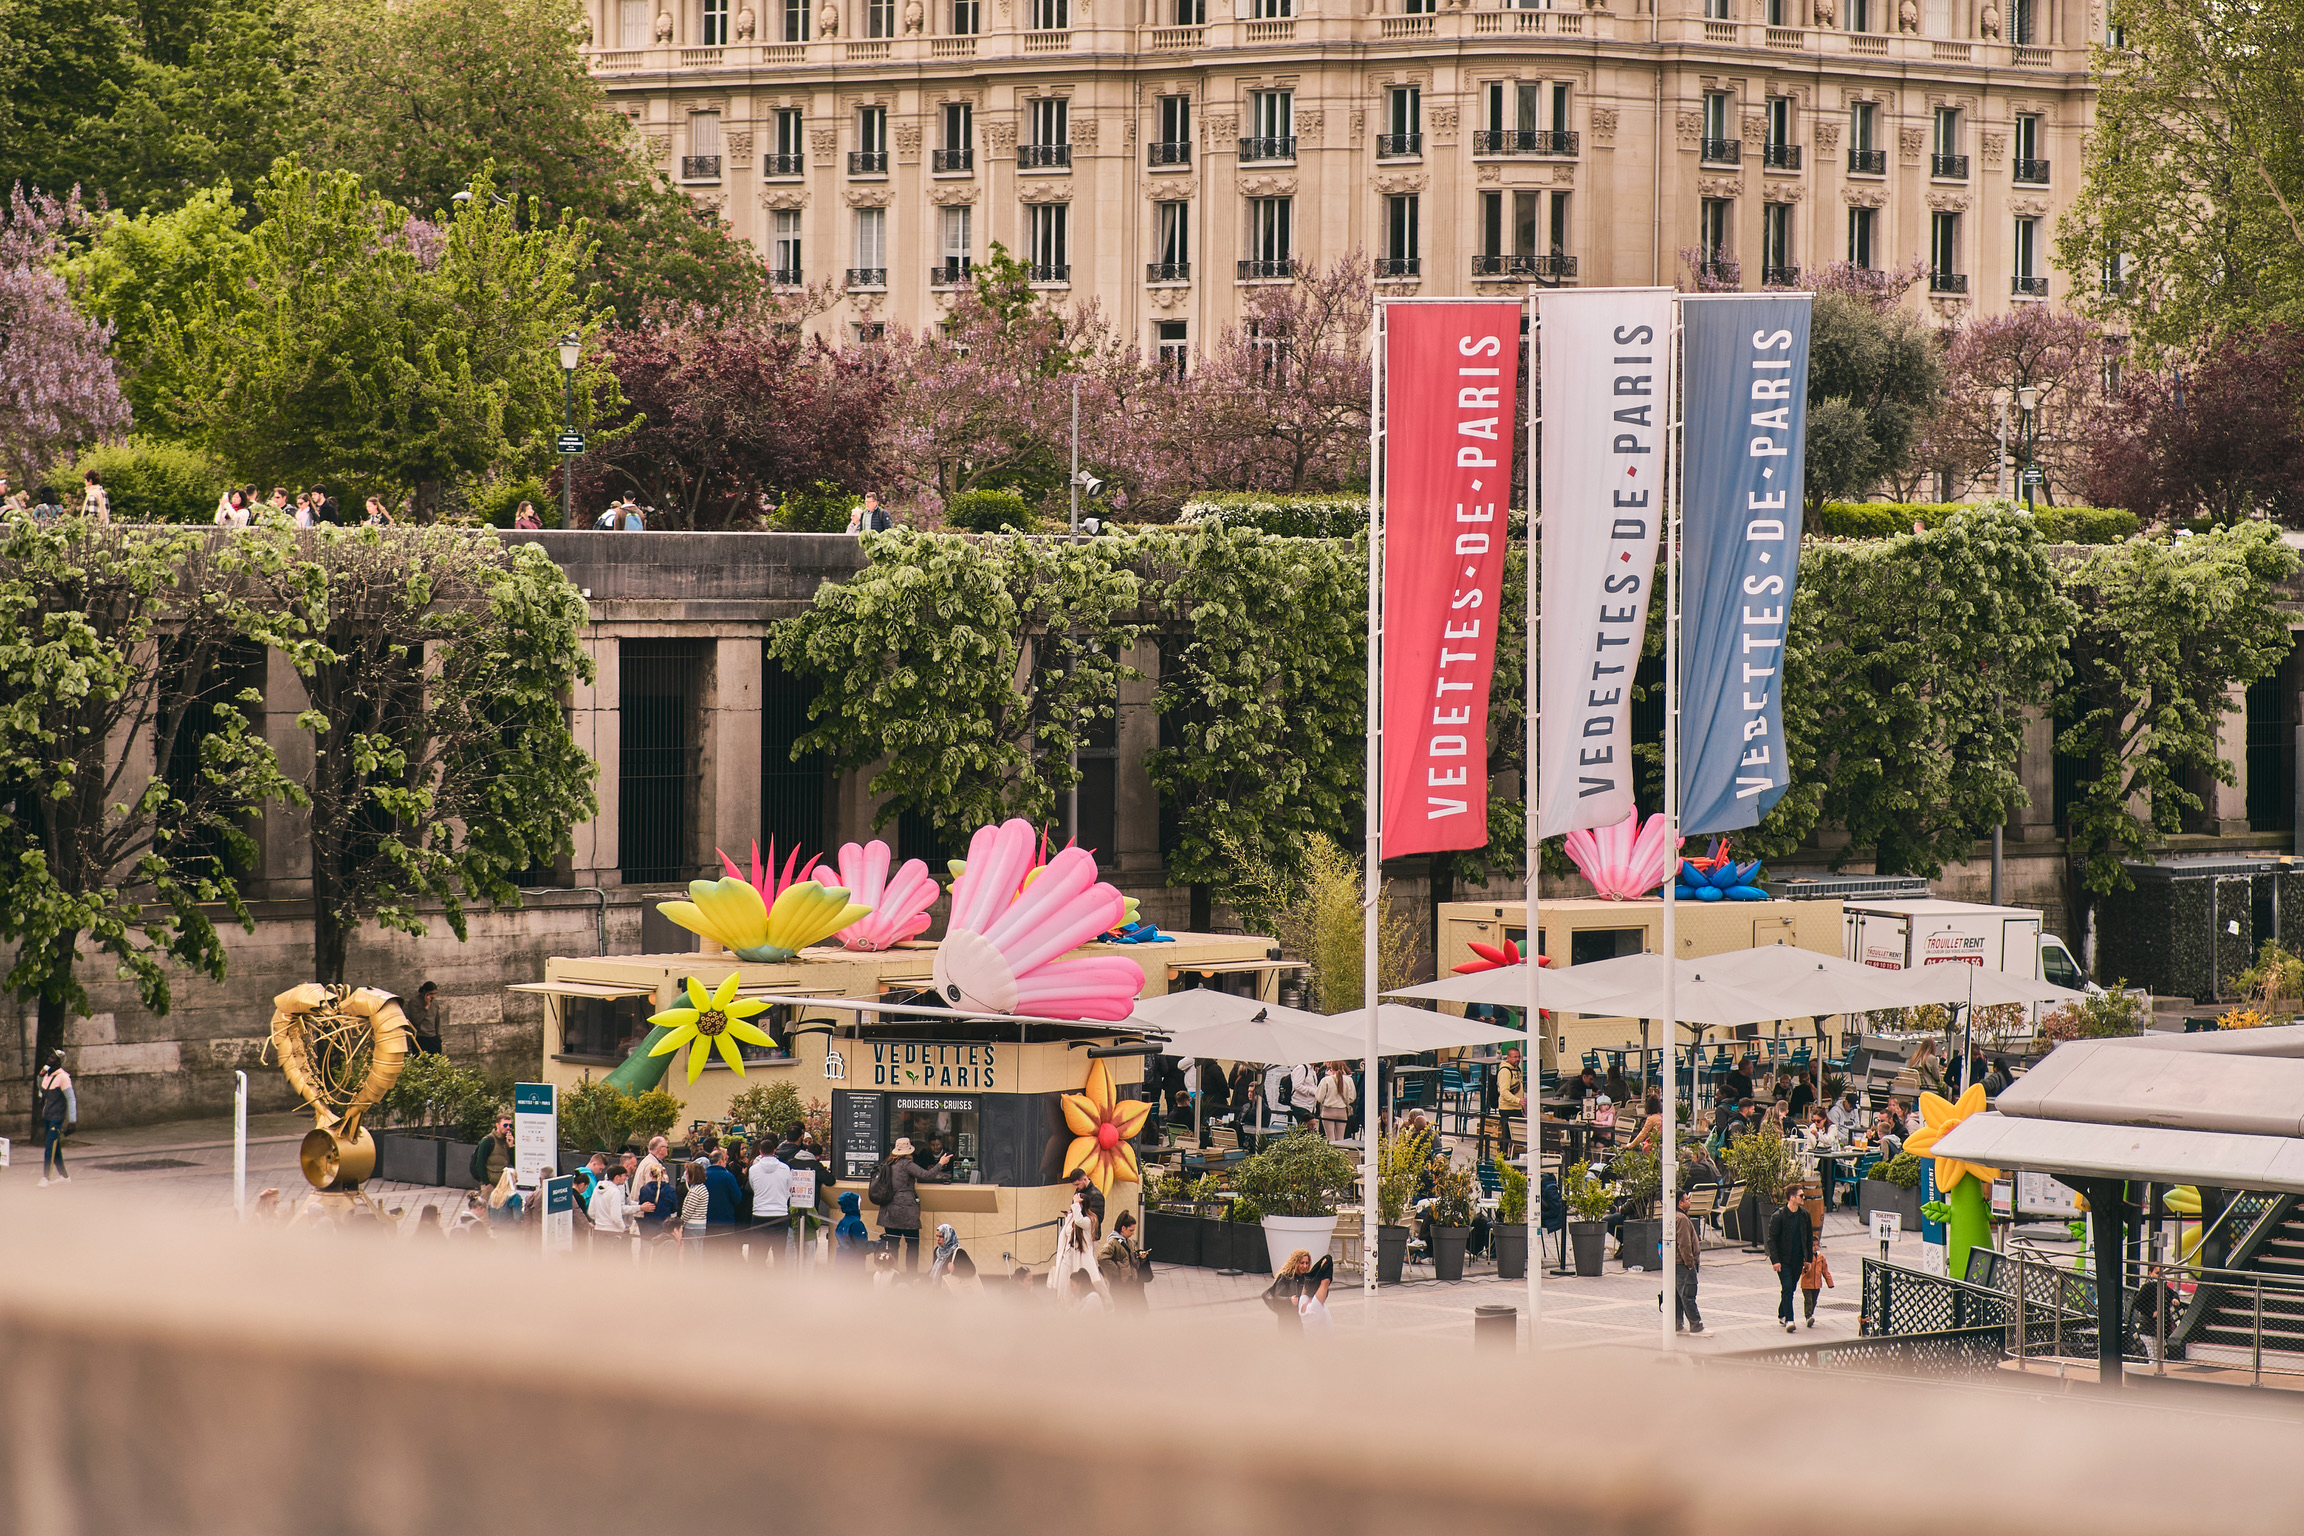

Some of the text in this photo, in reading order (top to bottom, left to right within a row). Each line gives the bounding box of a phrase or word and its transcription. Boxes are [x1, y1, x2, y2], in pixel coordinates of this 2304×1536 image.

[1749, 329, 1793, 457] PARIS
[1746, 490, 1786, 541] DE
[1427, 335, 1501, 820] VEDETTES DE PARIS
[1578, 325, 1653, 799] VEDETTES DE PARIS
[1927, 937, 1985, 949] TROUILLET RENT
[873, 1043, 995, 1066] VEDETTES
[875, 1064, 994, 1088] DE PARIS
[943, 1099, 973, 1110] CRUISES
[1928, 1166, 1936, 1226] EQUEMENT
